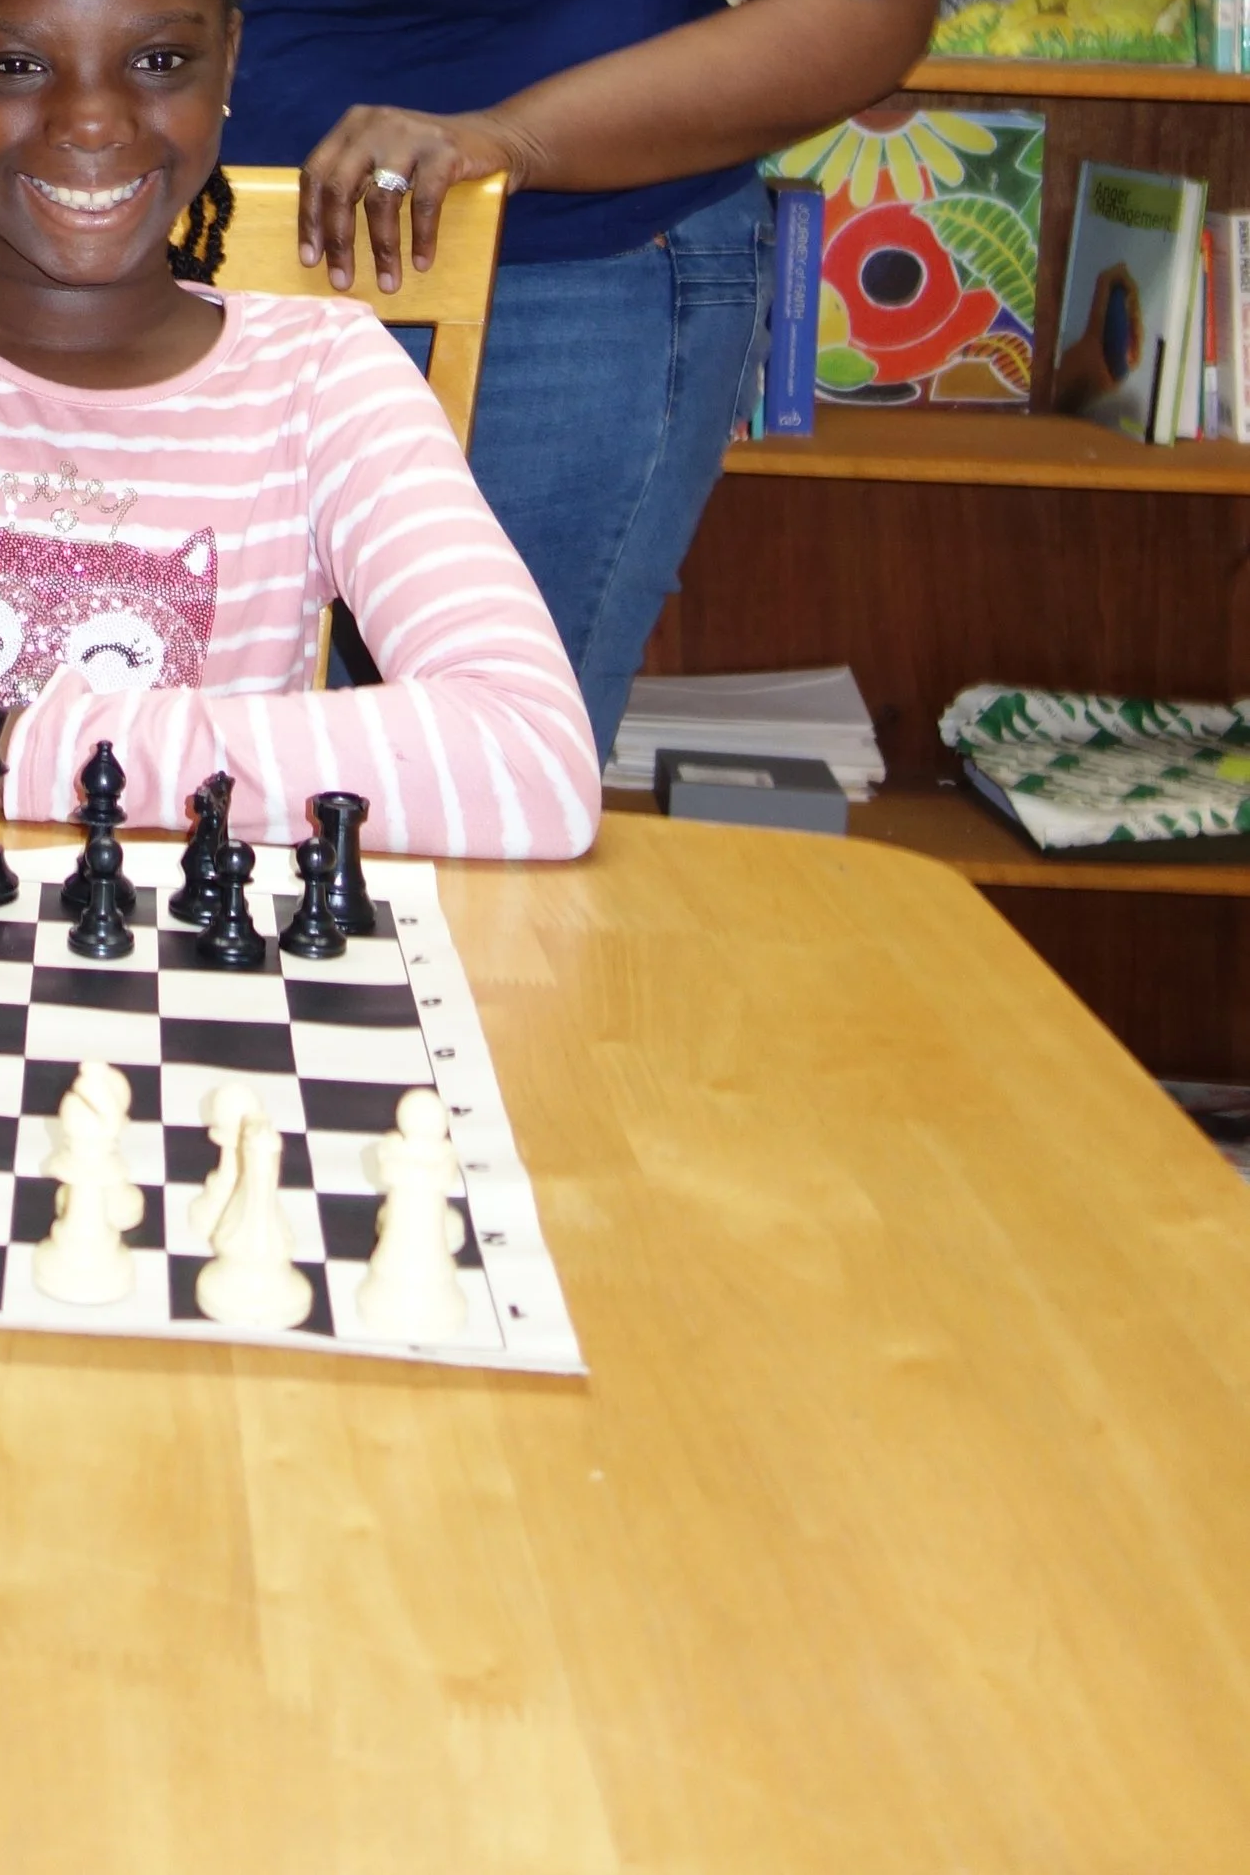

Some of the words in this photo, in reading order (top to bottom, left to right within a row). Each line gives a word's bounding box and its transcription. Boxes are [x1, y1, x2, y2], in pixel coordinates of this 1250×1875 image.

[1095, 182, 1131, 205] Anger
[1095, 199, 1173, 228] Management
[795, 202, 811, 265] JOURNEY
[794, 284, 807, 320] FAITH
